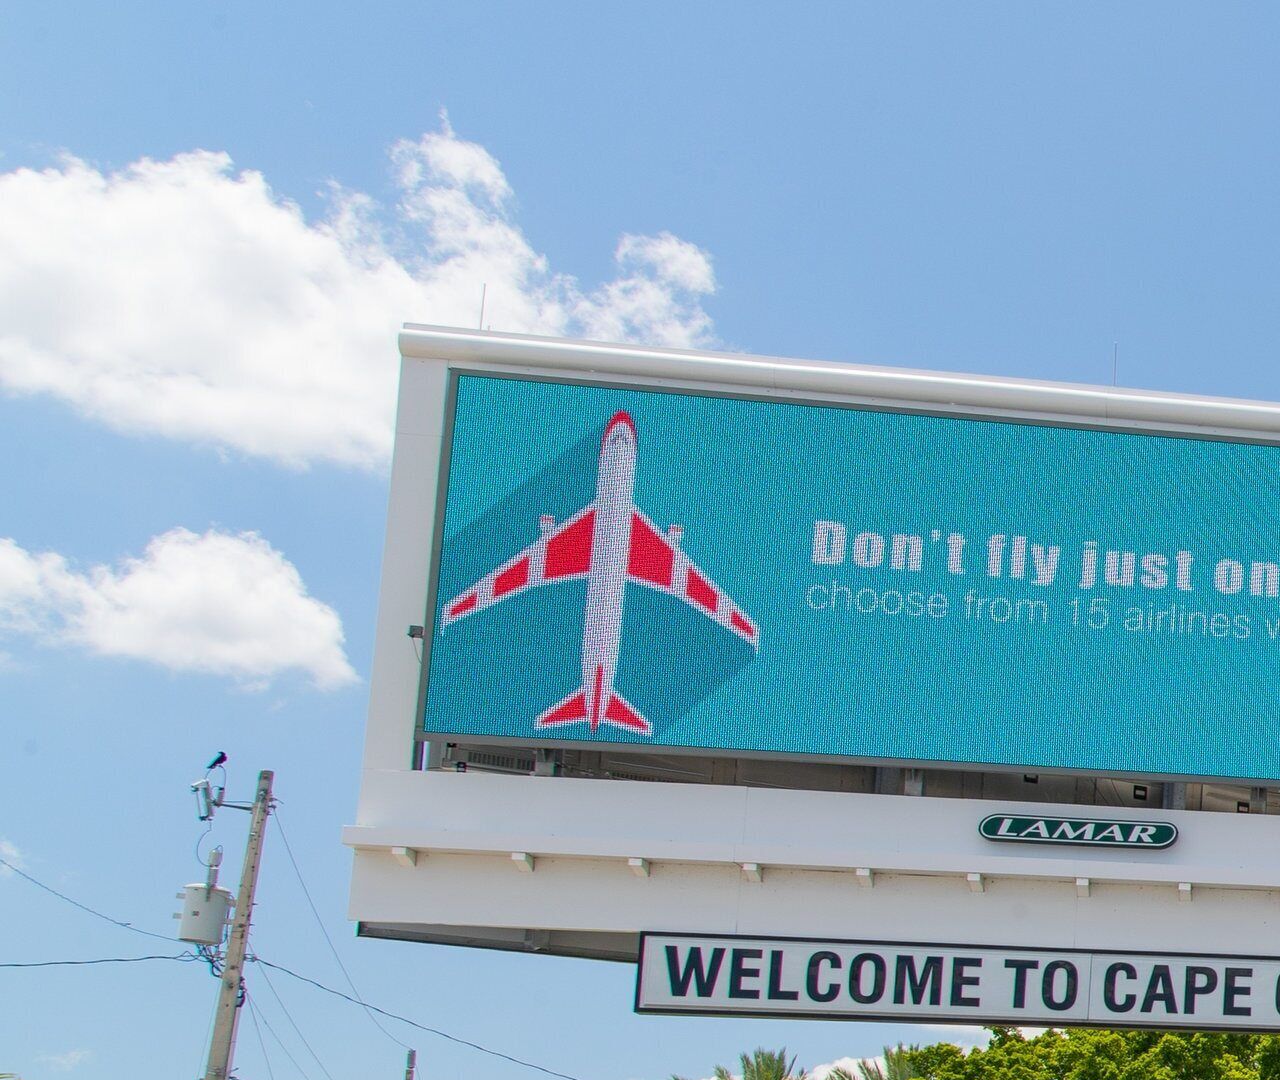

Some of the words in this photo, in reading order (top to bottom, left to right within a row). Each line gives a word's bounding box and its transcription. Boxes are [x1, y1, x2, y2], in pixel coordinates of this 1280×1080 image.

[812, 520, 965, 575] Don't
[987, 533, 1060, 586] fly
[1079, 541, 1192, 591] just
[806, 581, 948, 619] choose
[965, 588, 1048, 624] from
[1069, 596, 1110, 630] 15
[1124, 602, 1250, 639] airlines
[997, 818, 1157, 843] LAMAR
[665, 945, 983, 1007] WELCOME
[1004, 958, 1078, 1011] TO
[1104, 962, 1253, 1016] CAPE
